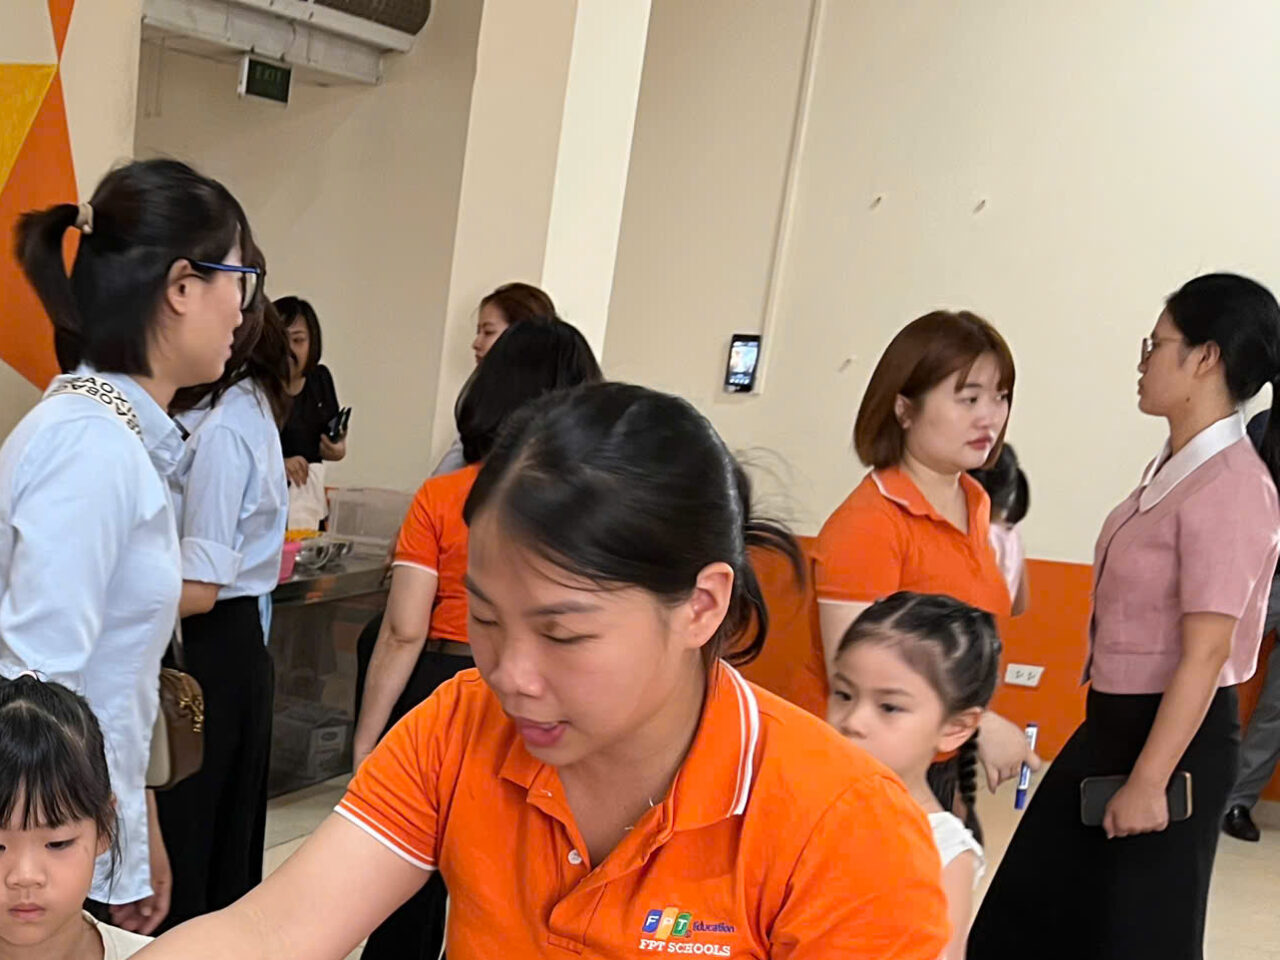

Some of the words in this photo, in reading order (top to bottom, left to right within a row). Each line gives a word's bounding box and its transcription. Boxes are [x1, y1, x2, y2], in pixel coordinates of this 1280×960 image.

[693, 920, 734, 933] Education
[639, 939, 665, 951] FPT
[668, 942, 731, 956] SCHOOLS
